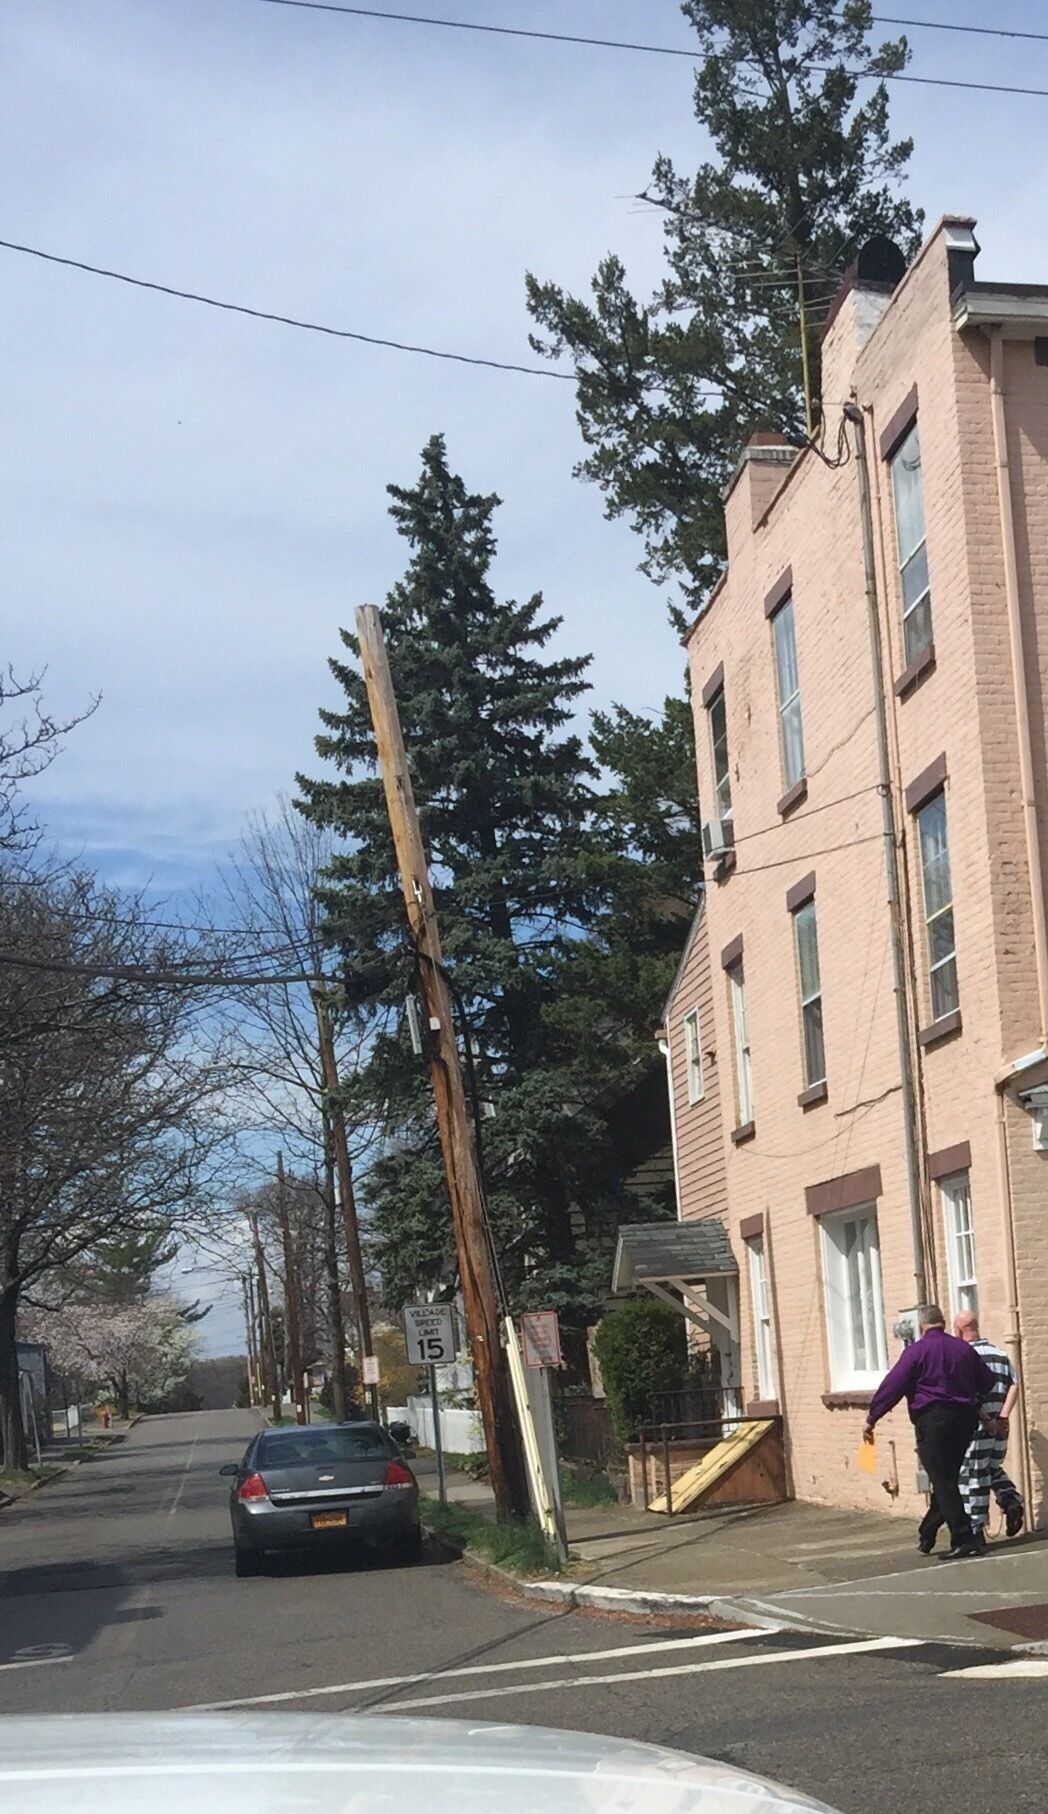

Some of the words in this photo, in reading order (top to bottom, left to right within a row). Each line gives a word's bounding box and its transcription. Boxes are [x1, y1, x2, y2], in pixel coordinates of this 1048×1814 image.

[409, 1307, 447, 1317] VILLAGE
[414, 1318, 442, 1328] SPEED
[418, 1328, 440, 1337] LIMIT
[416, 1337, 445, 1361] 15
